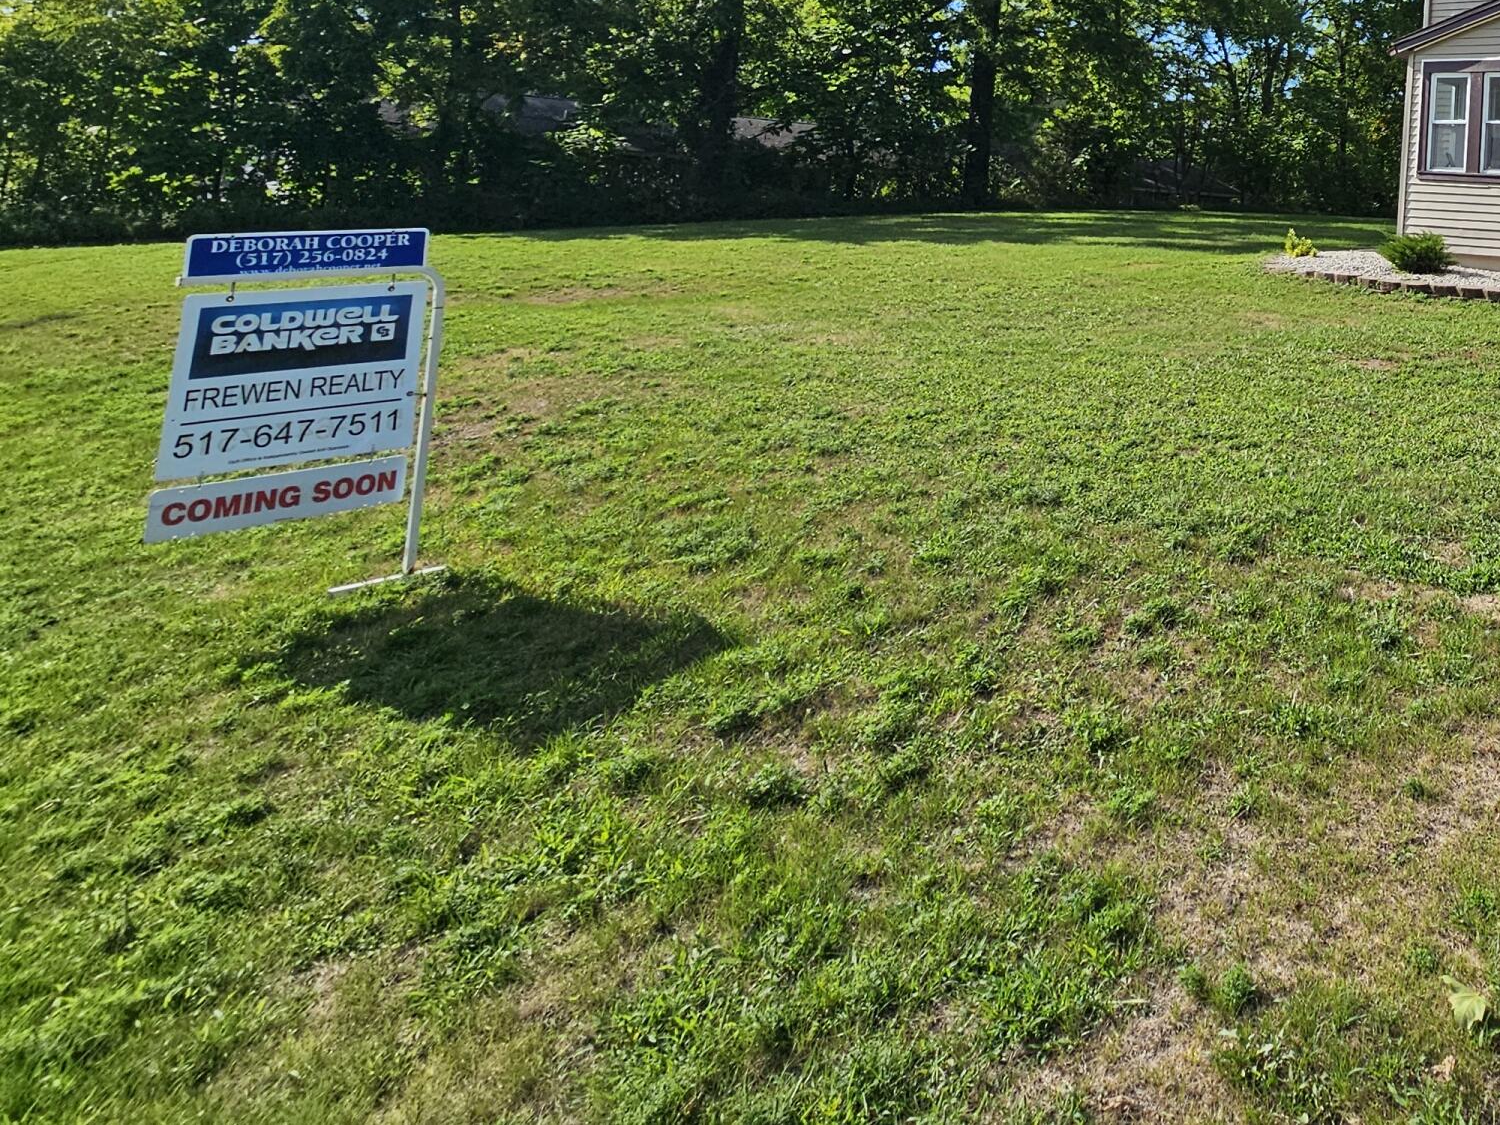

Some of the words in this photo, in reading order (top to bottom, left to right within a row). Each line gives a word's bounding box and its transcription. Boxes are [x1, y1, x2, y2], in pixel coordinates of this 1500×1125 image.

[211, 236, 320, 254] DEBORAH
[326, 233, 411, 249] COOPER
[236, 251, 292, 268] (517)
[298, 248, 389, 264] 256-0824
[211, 304, 400, 334] COLDWELL
[209, 325, 364, 355] BANKER
[183, 379, 303, 412] FREWEN
[309, 368, 406, 398] REALTY
[172, 409, 399, 459] 517-647-7511
[160, 486, 302, 527] COMING
[311, 470, 398, 503] SOON
